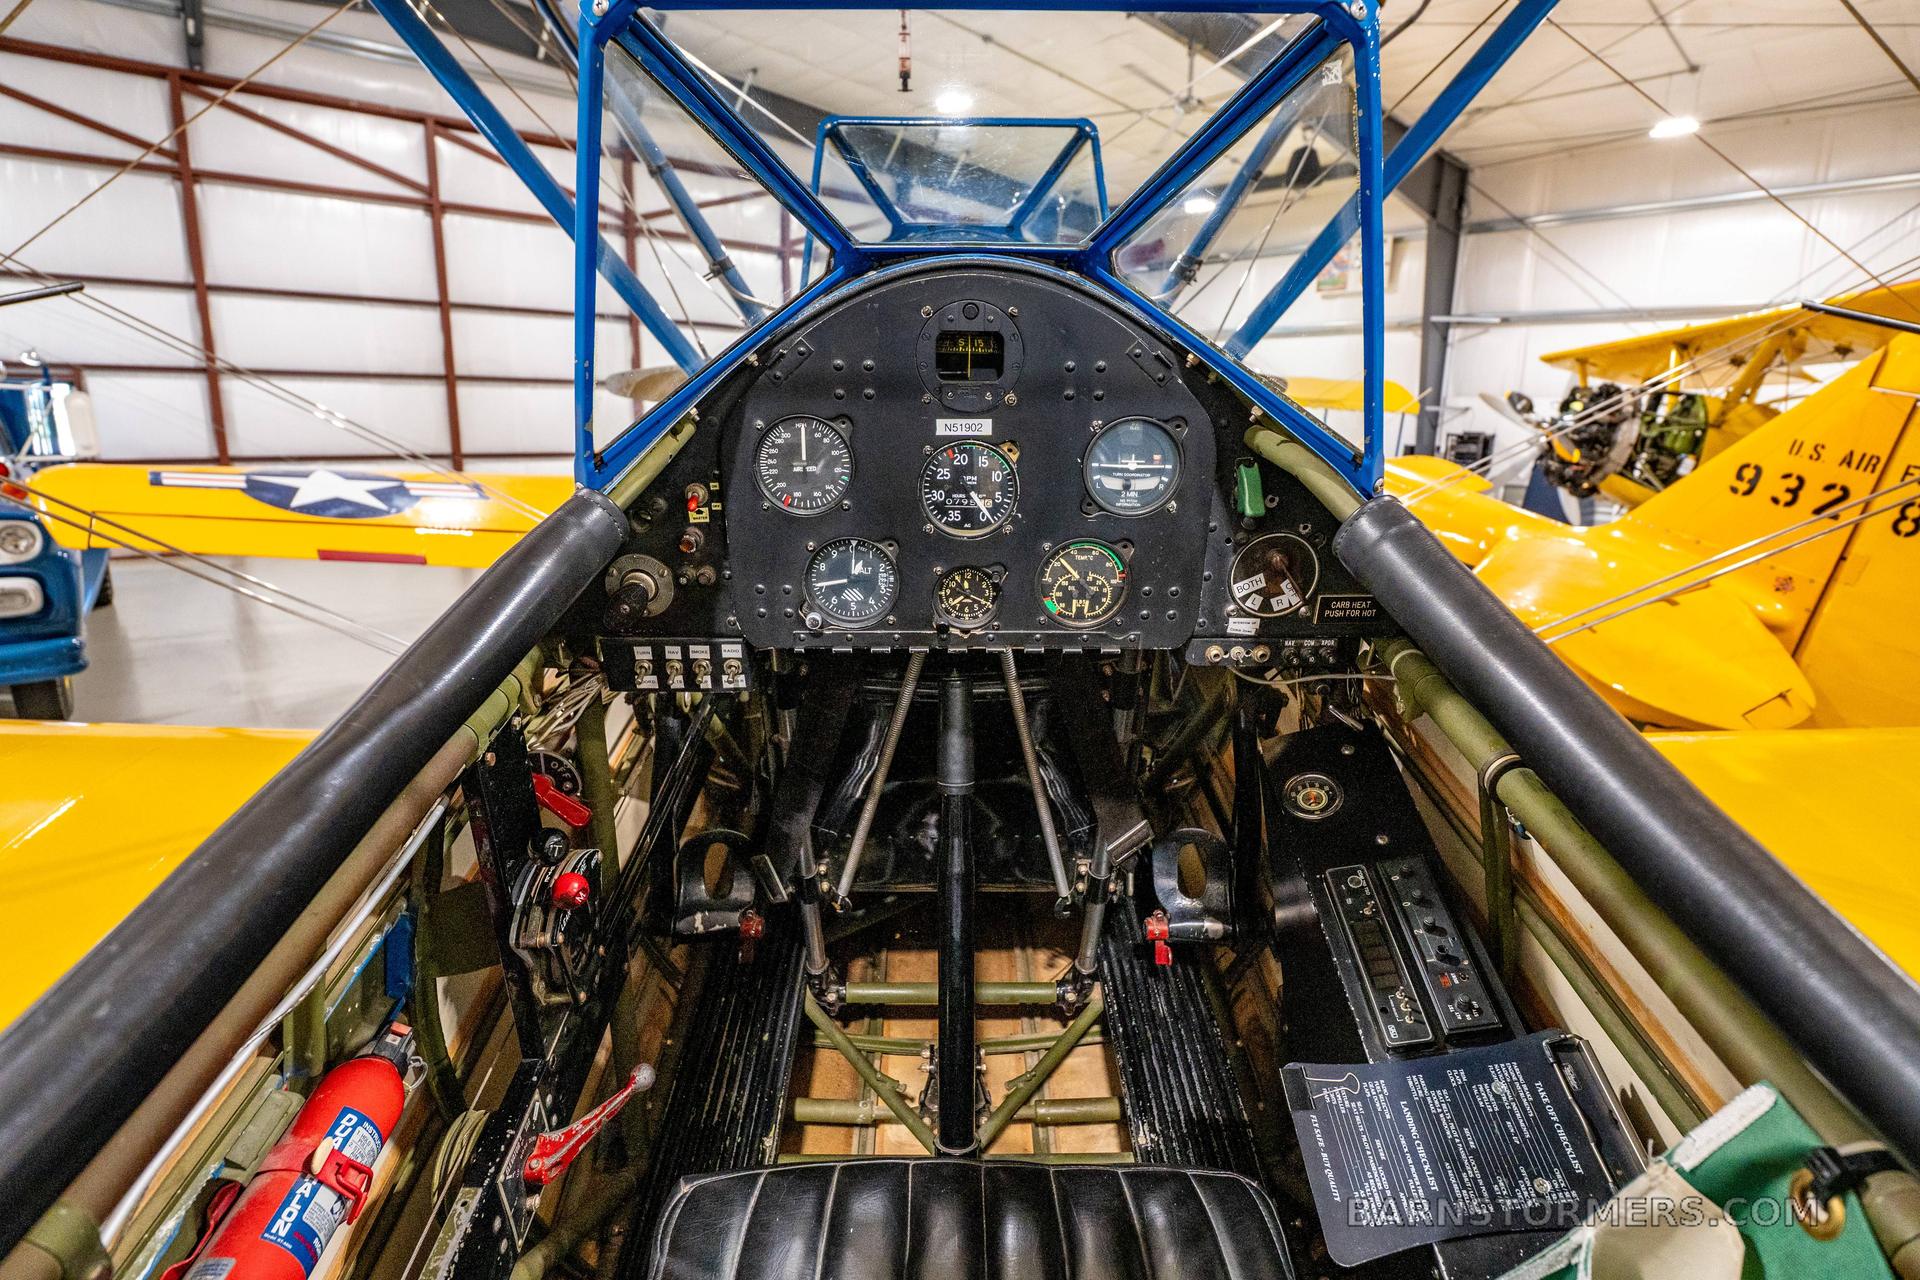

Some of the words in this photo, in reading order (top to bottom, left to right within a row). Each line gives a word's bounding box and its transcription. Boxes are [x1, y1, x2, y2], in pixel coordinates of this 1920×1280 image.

[944, 423, 983, 432] N51902
[954, 454, 968, 465] 20
[978, 456, 989, 467] 15
[1839, 450, 1882, 474] AIR
[937, 469, 951, 480] 25
[992, 471, 1002, 482] 10
[931, 490, 945, 501] 30
[995, 492, 1002, 503] 5
[948, 511, 961, 521] 35
[832, 550, 838, 559] 9
[869, 551, 873, 559] 1
[820, 563, 826, 571] 8
[880, 564, 886, 572] 2
[1236, 577, 1263, 594] BOTH
[832, 596, 838, 604] 6
[869, 597, 875, 605] 4
[1252, 598, 1257, 606] L
[1276, 599, 1284, 607] R
[1331, 601, 1351, 609] CARB
[1352, 601, 1372, 609] HEAT
[851, 602, 857, 611] 5
[1324, 610, 1345, 618] PUSH
[1345, 609, 1361, 617] FOR
[1362, 609, 1377, 617] HOT
[550, 761, 572, 779] OFF
[575, 892, 586, 903] M
[1535, 1081, 1551, 1105] TAKE
[1546, 1104, 1559, 1122] OFF
[1555, 1123, 1584, 1175] CHECKLIST
[1400, 1101, 1419, 1138] LANDING
[1413, 1139, 1438, 1191] CHECKLIST
[1324, 1168, 1340, 1202] QUALITY
